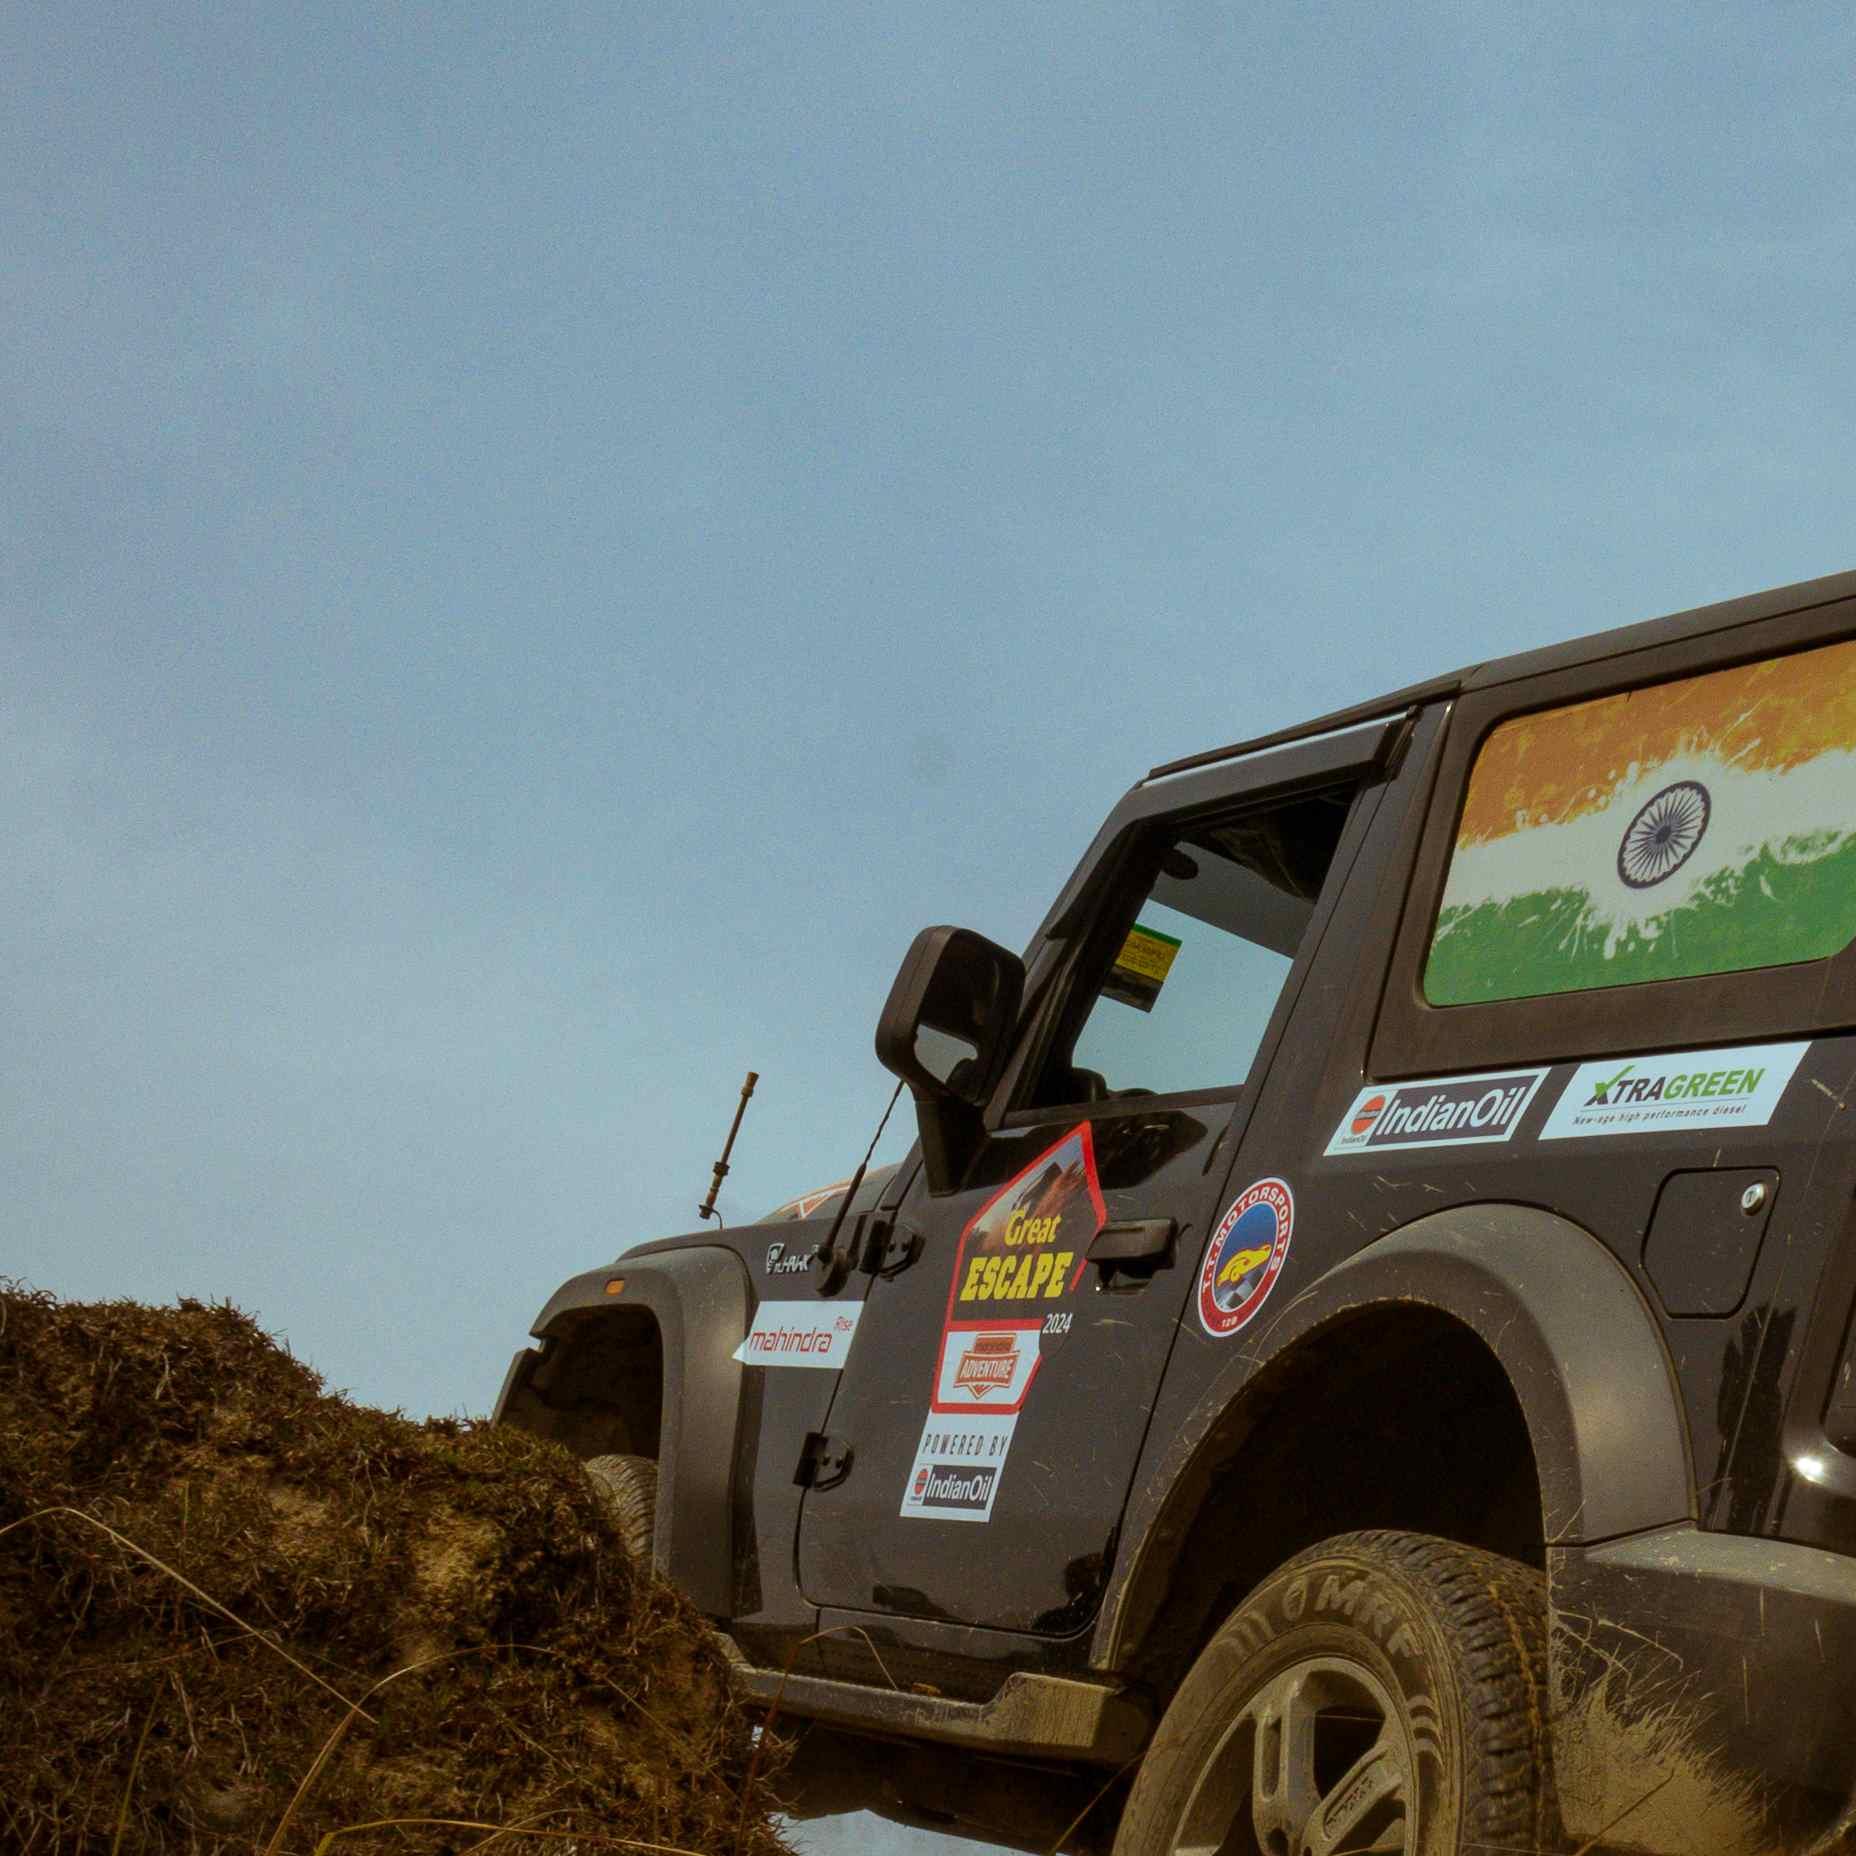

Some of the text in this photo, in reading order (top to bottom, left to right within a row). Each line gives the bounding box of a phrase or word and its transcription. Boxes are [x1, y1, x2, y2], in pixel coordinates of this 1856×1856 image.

[1583, 1065, 1765, 1107] XTRAGREEN
[1376, 1086, 1527, 1136] IndianOil
[1618, 1113, 1640, 1123] high
[1643, 1108, 1709, 1121] performance
[1712, 1104, 1747, 1115] diesel
[1004, 1208, 1061, 1246] Great
[1215, 1187, 1289, 1270] MOTORSPORTS
[960, 1251, 1074, 1301] ESCAPE
[749, 1326, 833, 1353] mahindra
[1042, 1312, 1074, 1334] 2024
[960, 1358, 1013, 1379] ADVENTURE
[922, 1433, 1008, 1456] POWERED BY
[927, 1472, 993, 1501] IndianOil
[1314, 1573, 1418, 1662] MRF
